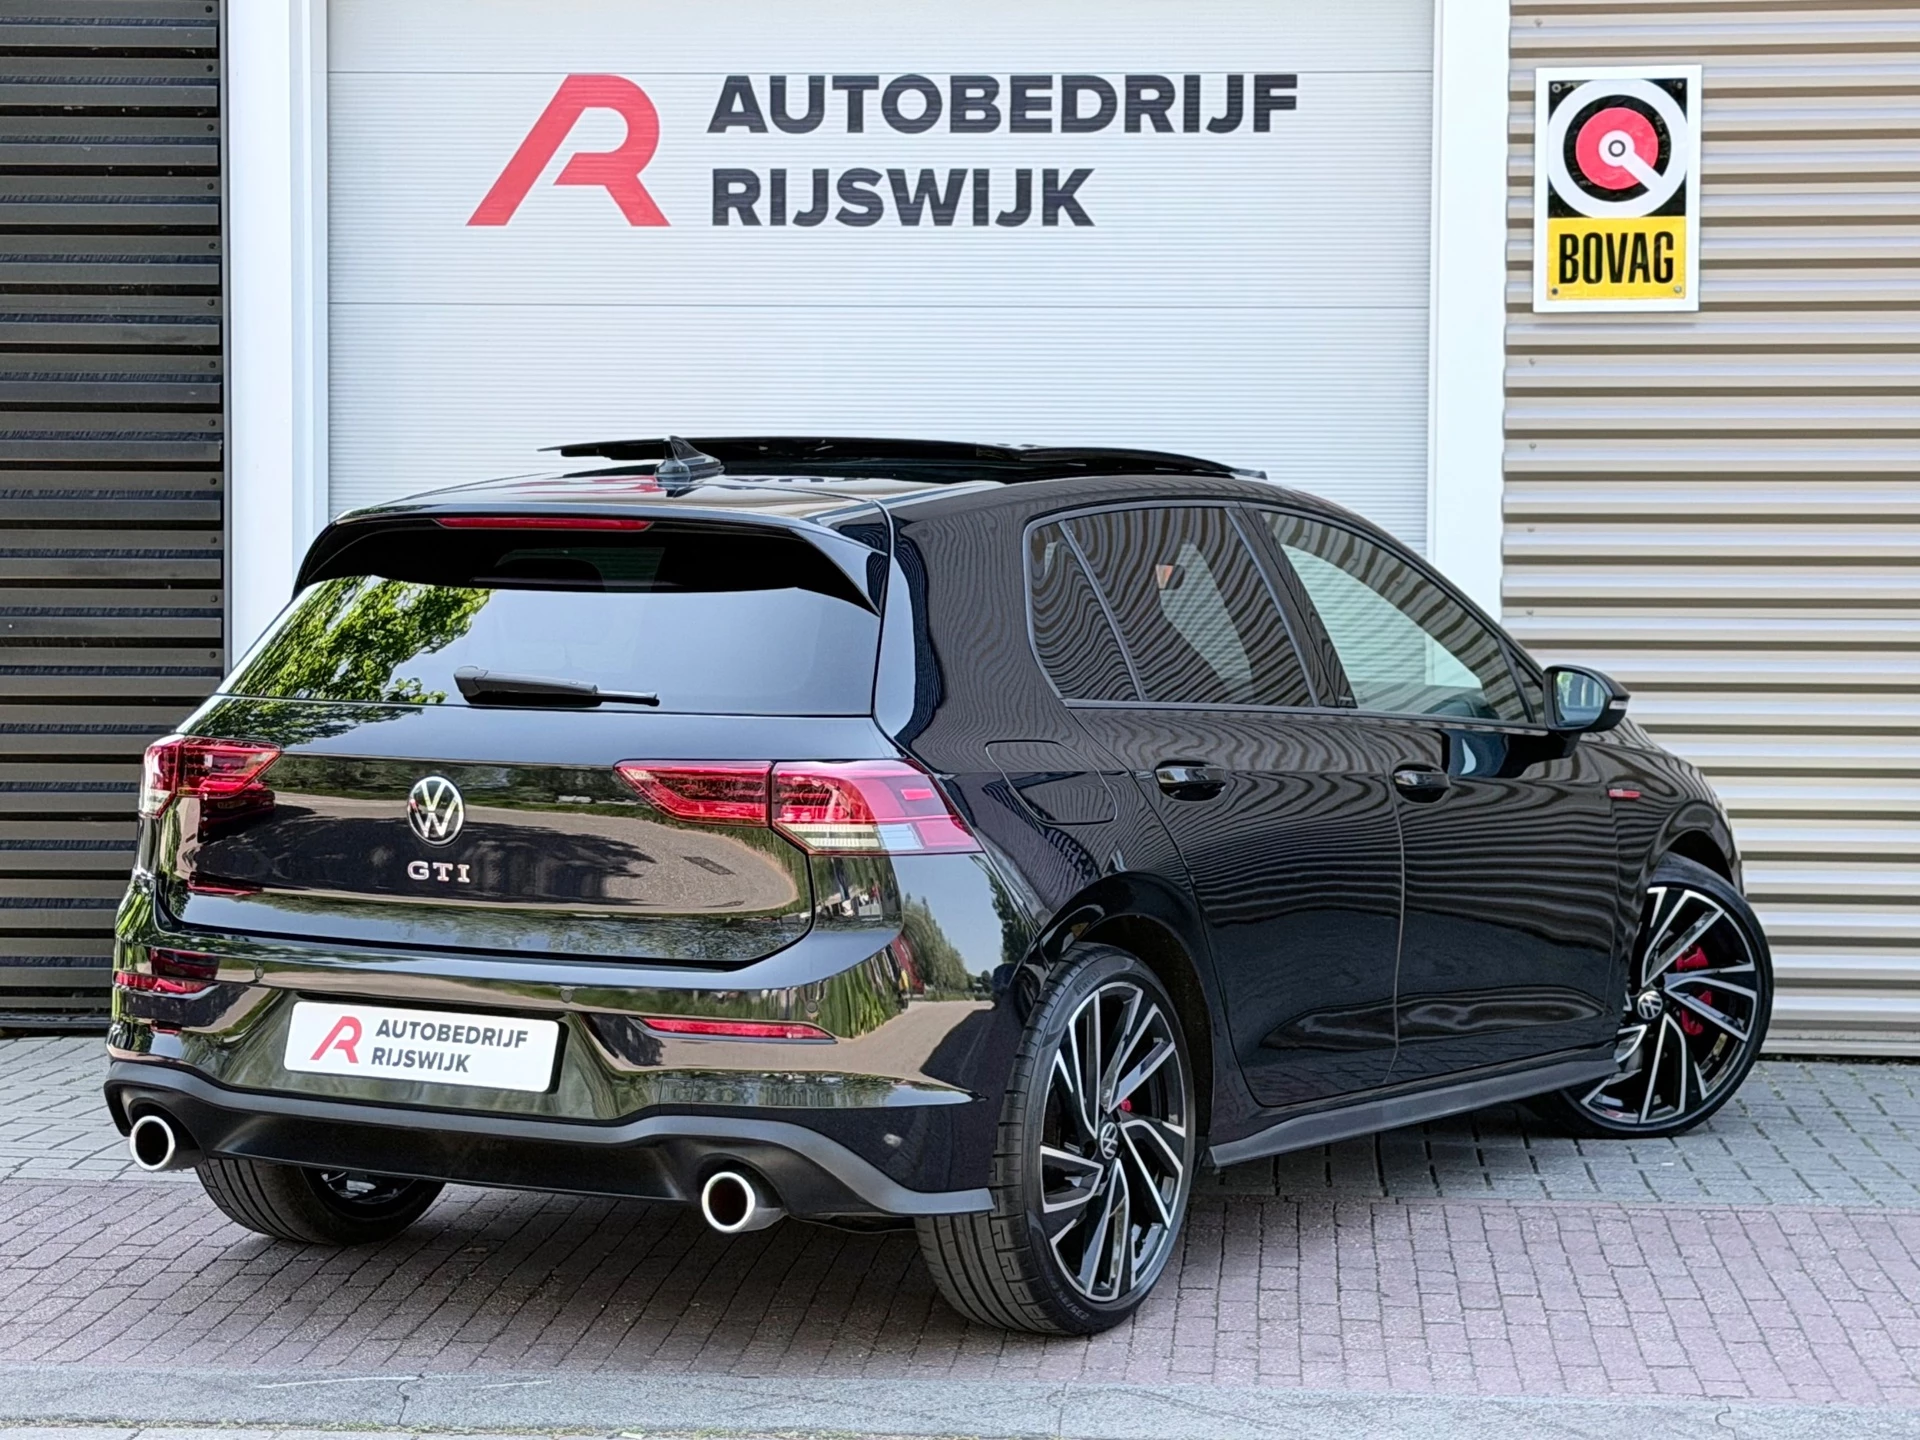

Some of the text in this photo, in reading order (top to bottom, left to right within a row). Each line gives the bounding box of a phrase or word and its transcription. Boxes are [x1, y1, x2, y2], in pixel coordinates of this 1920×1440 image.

[706, 74, 1298, 134] AUTOBEDRIJF
[711, 167, 1096, 227] RIJSWIJK
[1558, 231, 1674, 284] BOVAG
[407, 860, 471, 883] GTI
[375, 1018, 529, 1049] AUTOBEDRIJF
[370, 1046, 472, 1073] RIJSWIJK
